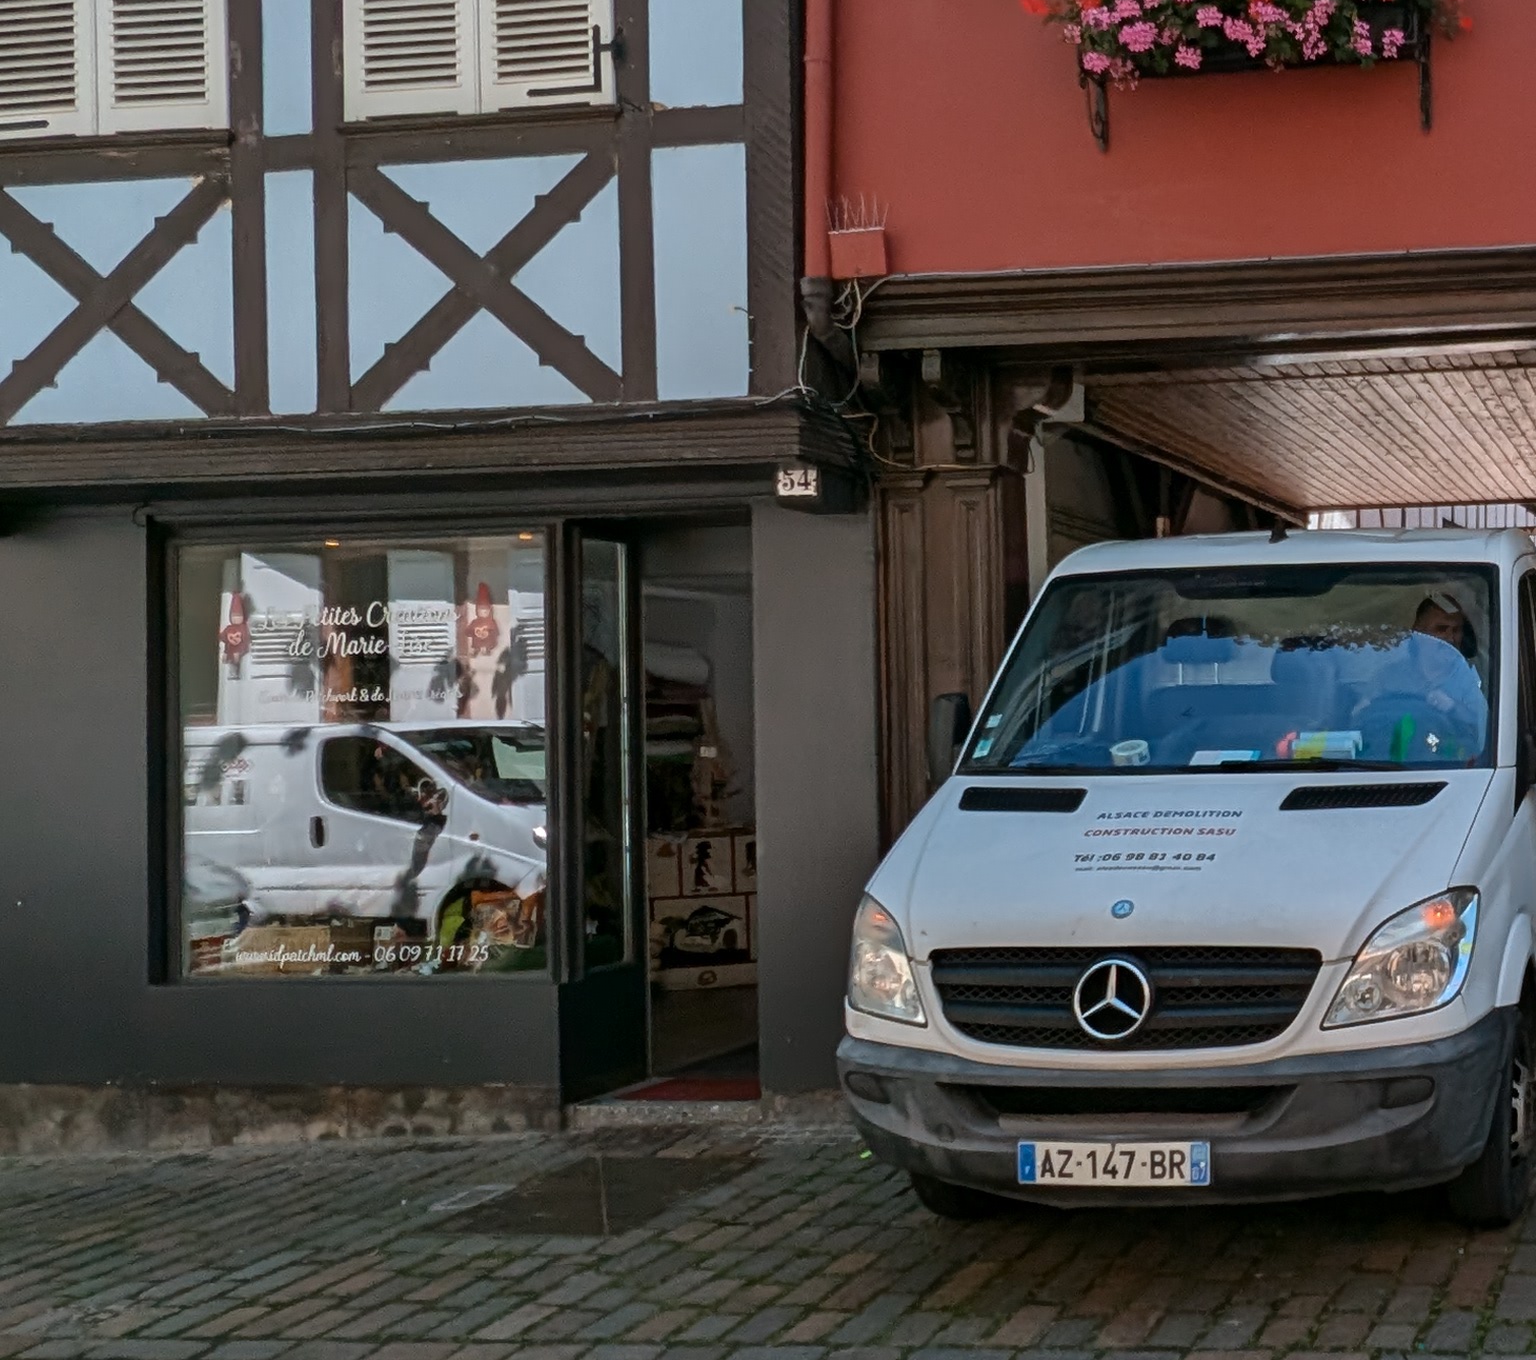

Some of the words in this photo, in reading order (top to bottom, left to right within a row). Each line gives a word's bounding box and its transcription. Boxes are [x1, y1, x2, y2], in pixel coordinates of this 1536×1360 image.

[782, 468, 812, 492] 54
[288, 629, 314, 658] de
[305, 686, 359, 703] Pchwork
[358, 688, 369, 703] &
[370, 686, 386, 703] de
[1096, 810, 1151, 820] ALSACE
[1152, 809, 1243, 819] DEMOLITION
[1083, 827, 1195, 838] CONSTRUCTION
[1196, 827, 1238, 837] SASU
[1125, 852, 1146, 862] 98
[1172, 852, 1192, 862] 40
[1195, 852, 1217, 862] 84
[374, 944, 397, 963] 06
[399, 944, 421, 963] 09
[424, 944, 442, 963] 71
[445, 944, 465, 963] 17
[468, 944, 490, 963] 25
[1040, 1149, 1187, 1180] AZ-147-BR
